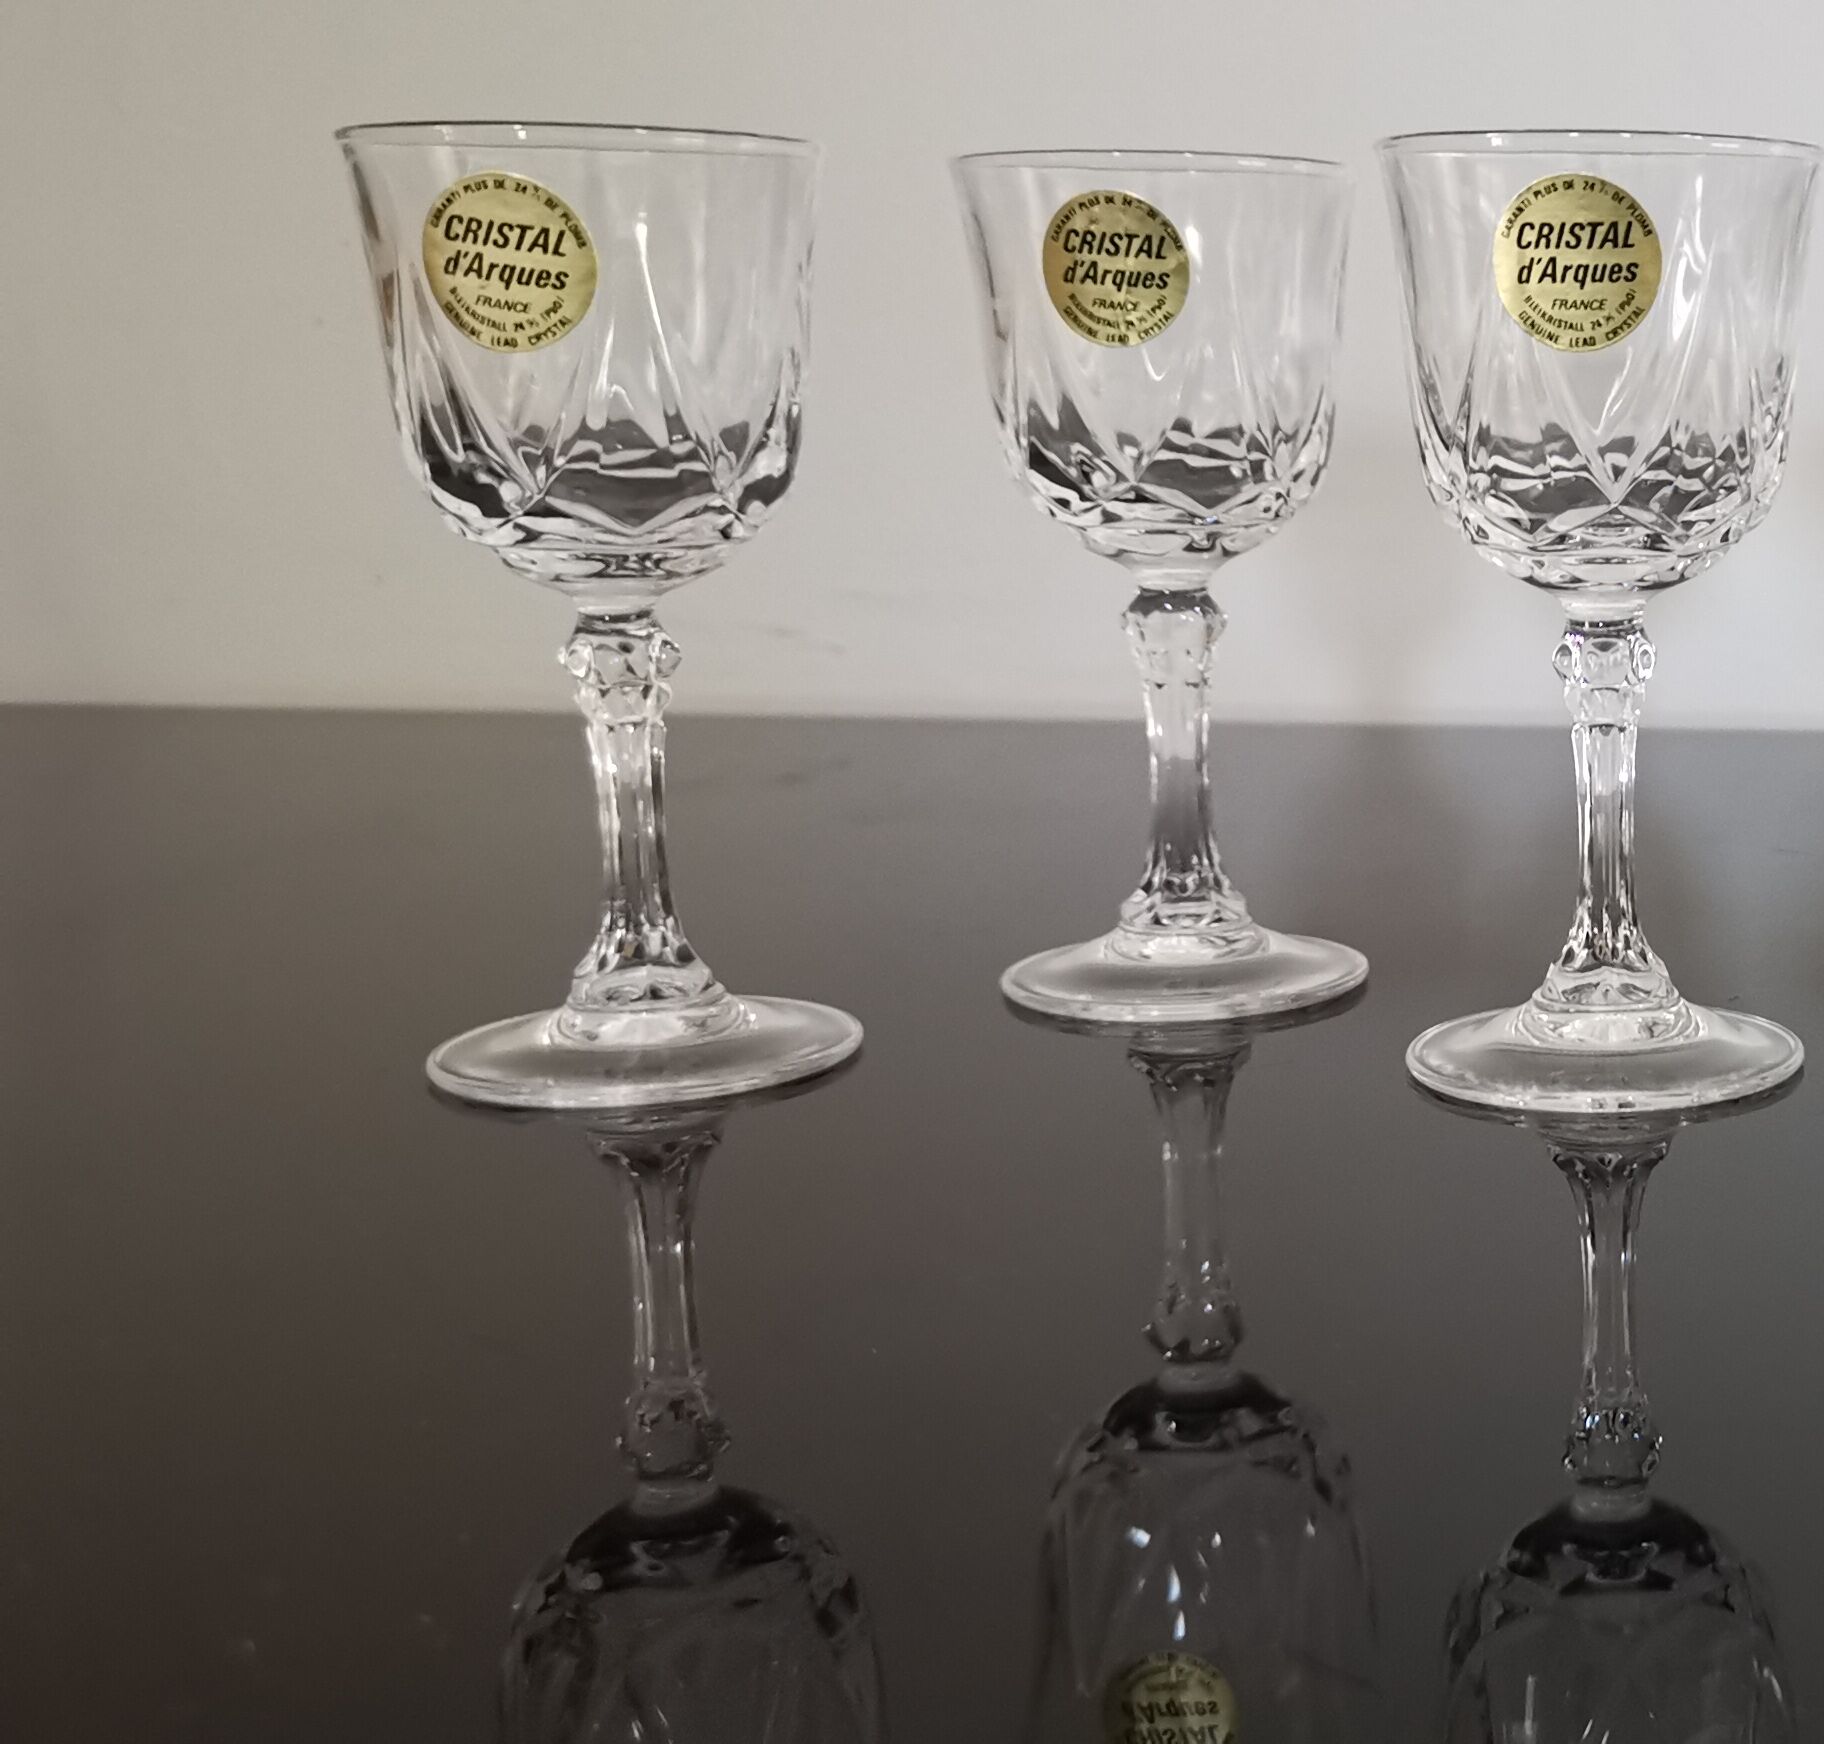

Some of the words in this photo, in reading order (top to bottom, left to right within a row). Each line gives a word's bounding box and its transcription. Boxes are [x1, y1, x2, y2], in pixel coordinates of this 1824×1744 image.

[1533, 183, 1558, 200] PLUS
[1563, 179, 1575, 190] DE
[1583, 180, 1596, 192] 24
[444, 214, 567, 257] CRISTAL
[1063, 228, 1168, 260] CRISTAL
[1517, 221, 1635, 250] CRISTAL
[444, 250, 570, 291] d'Arques
[1063, 259, 1170, 292] d'Arques
[1517, 256, 1639, 290] d'Arques
[475, 294, 532, 314] FRANCE
[1551, 299, 1608, 311] FRANCE
[1569, 337, 1596, 348] LEAD
[1606, 307, 1646, 342] CRYSTAL
